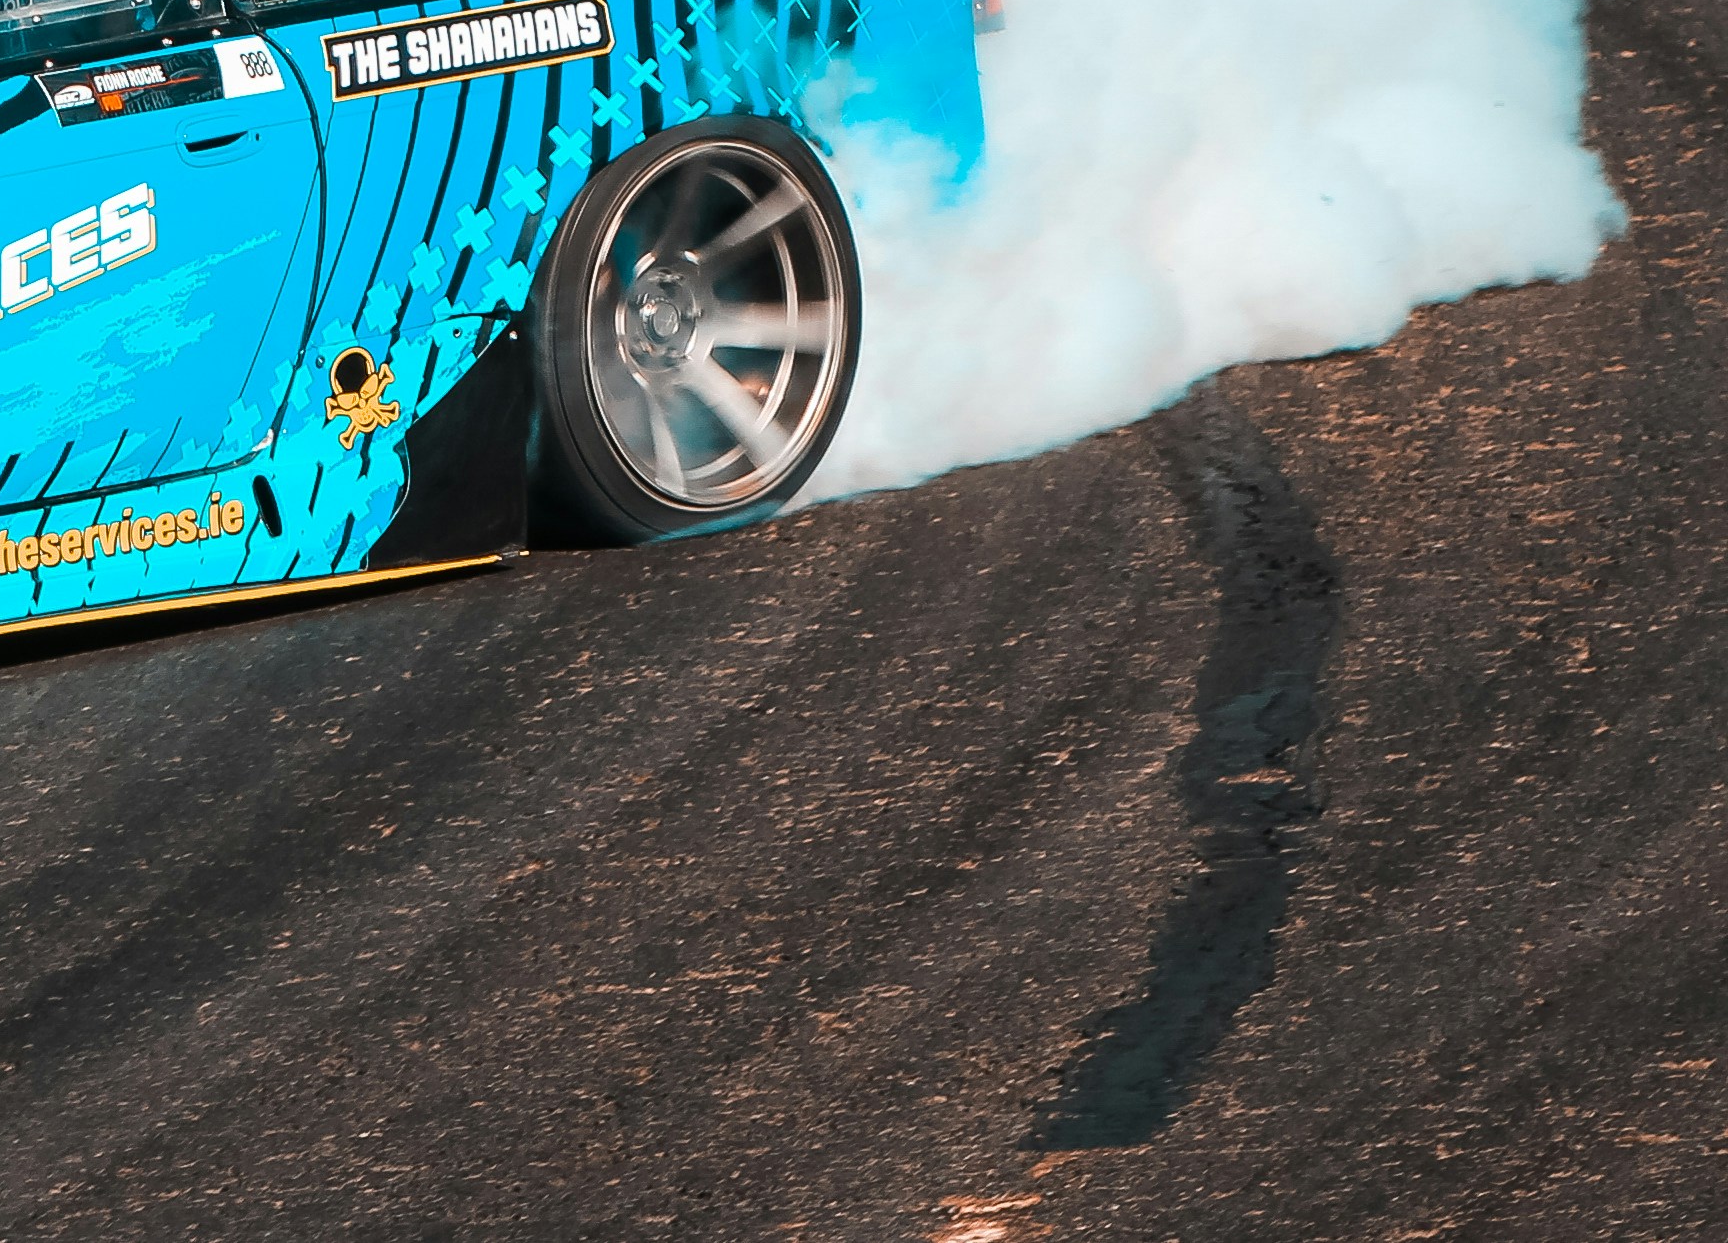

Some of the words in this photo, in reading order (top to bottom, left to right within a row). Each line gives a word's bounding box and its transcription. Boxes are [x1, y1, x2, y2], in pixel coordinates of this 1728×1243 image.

[332, 34, 401, 87] THE
[406, 1, 602, 75] SHANAHANS
[240, 51, 273, 78] 888
[94, 71, 129, 93] FIONN
[127, 65, 166, 88] ROCHE
